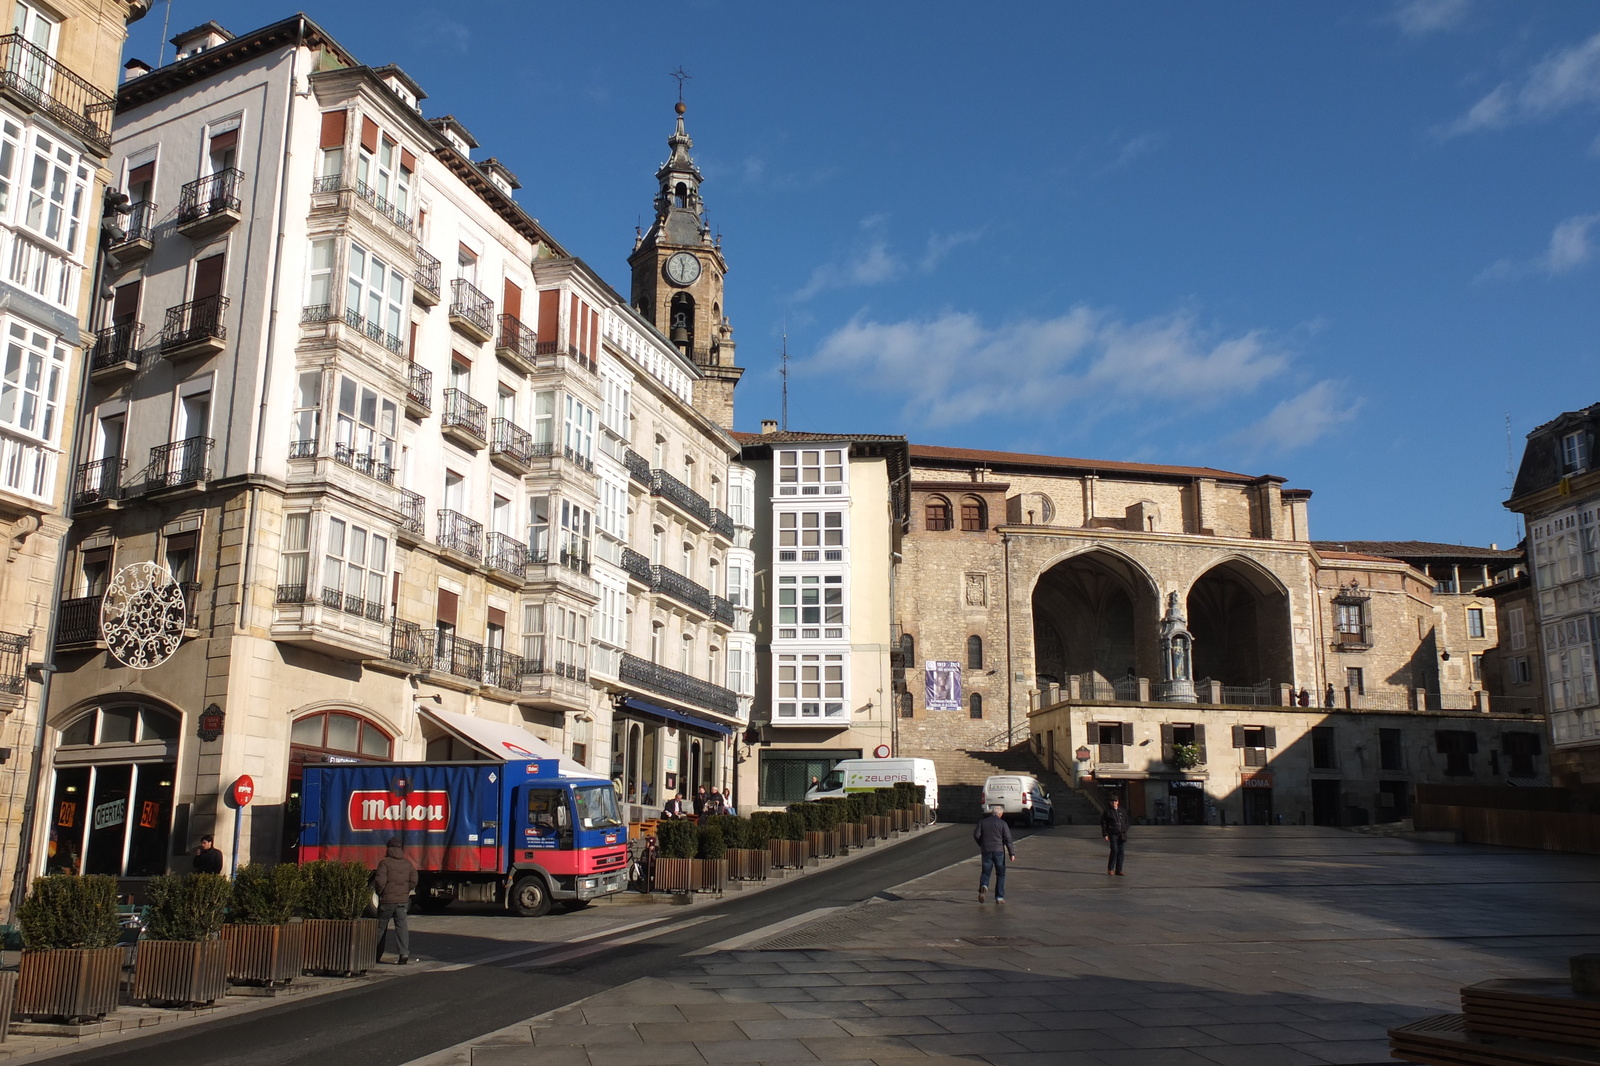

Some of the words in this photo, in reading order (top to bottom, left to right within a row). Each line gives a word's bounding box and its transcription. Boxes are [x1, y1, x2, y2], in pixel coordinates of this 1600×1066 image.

[1245, 779, 1270, 787] ROMA
[60, 803, 72, 824] 20
[96, 803, 126, 825] OFERTAS
[142, 803, 154, 825] 50
[361, 798, 444, 821] Mahou
